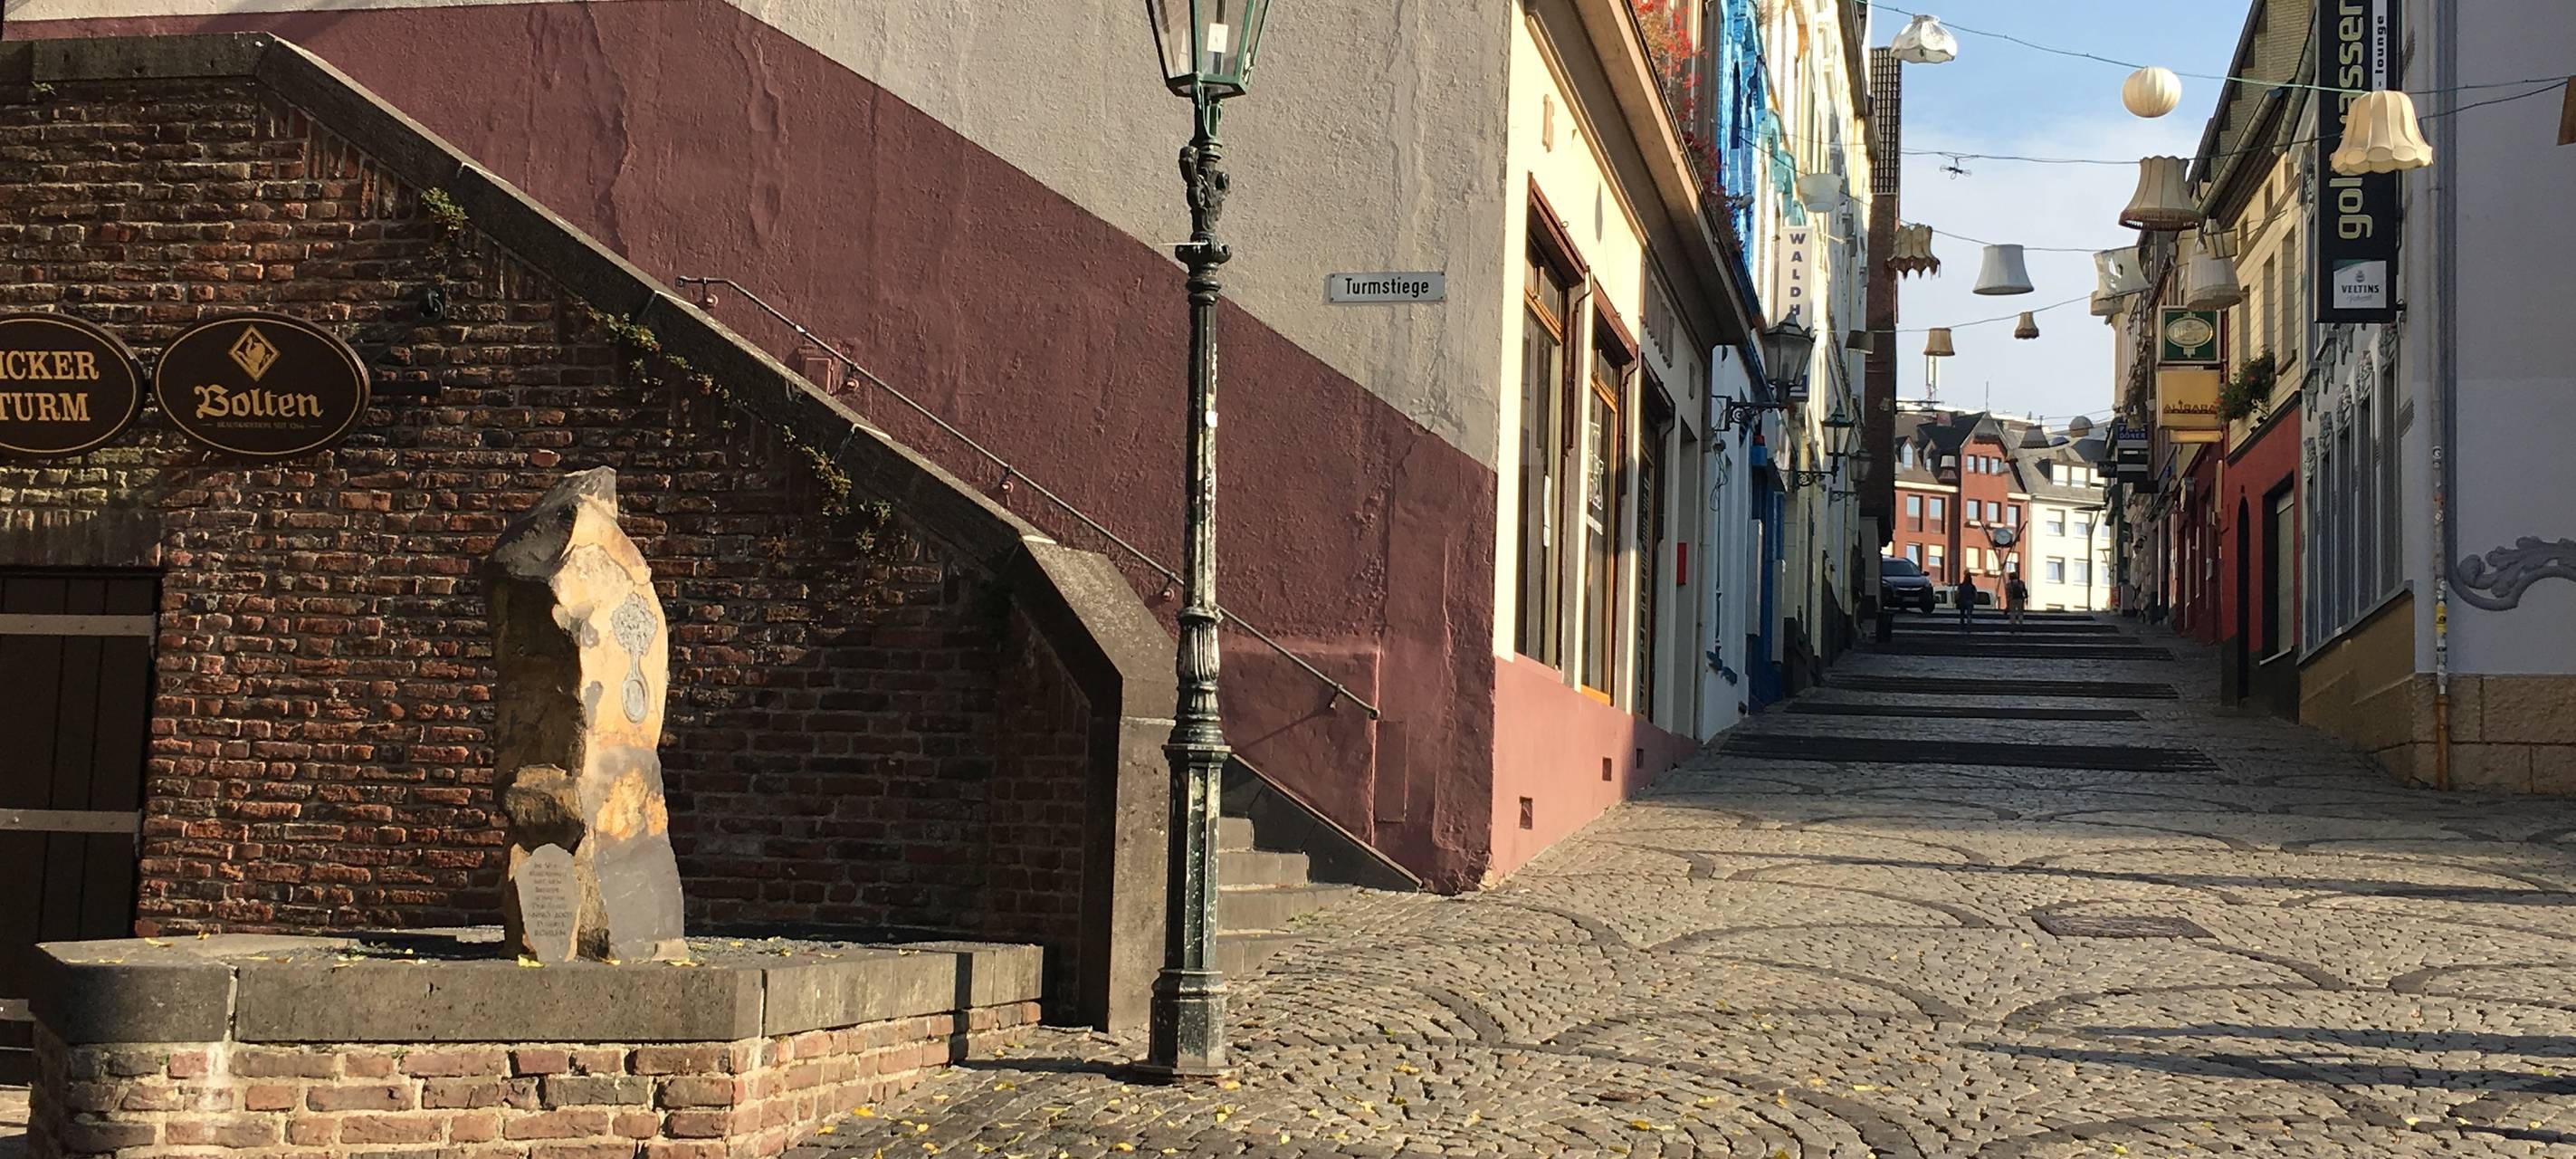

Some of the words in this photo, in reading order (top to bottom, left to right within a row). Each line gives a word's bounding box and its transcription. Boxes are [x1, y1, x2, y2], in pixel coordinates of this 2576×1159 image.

[2374, 15, 2387, 74] lounge
[1345, 276, 1429, 299] Turmstiege
[2341, 284, 2380, 294] VELTINS
[194, 384, 324, 419] Bolten
